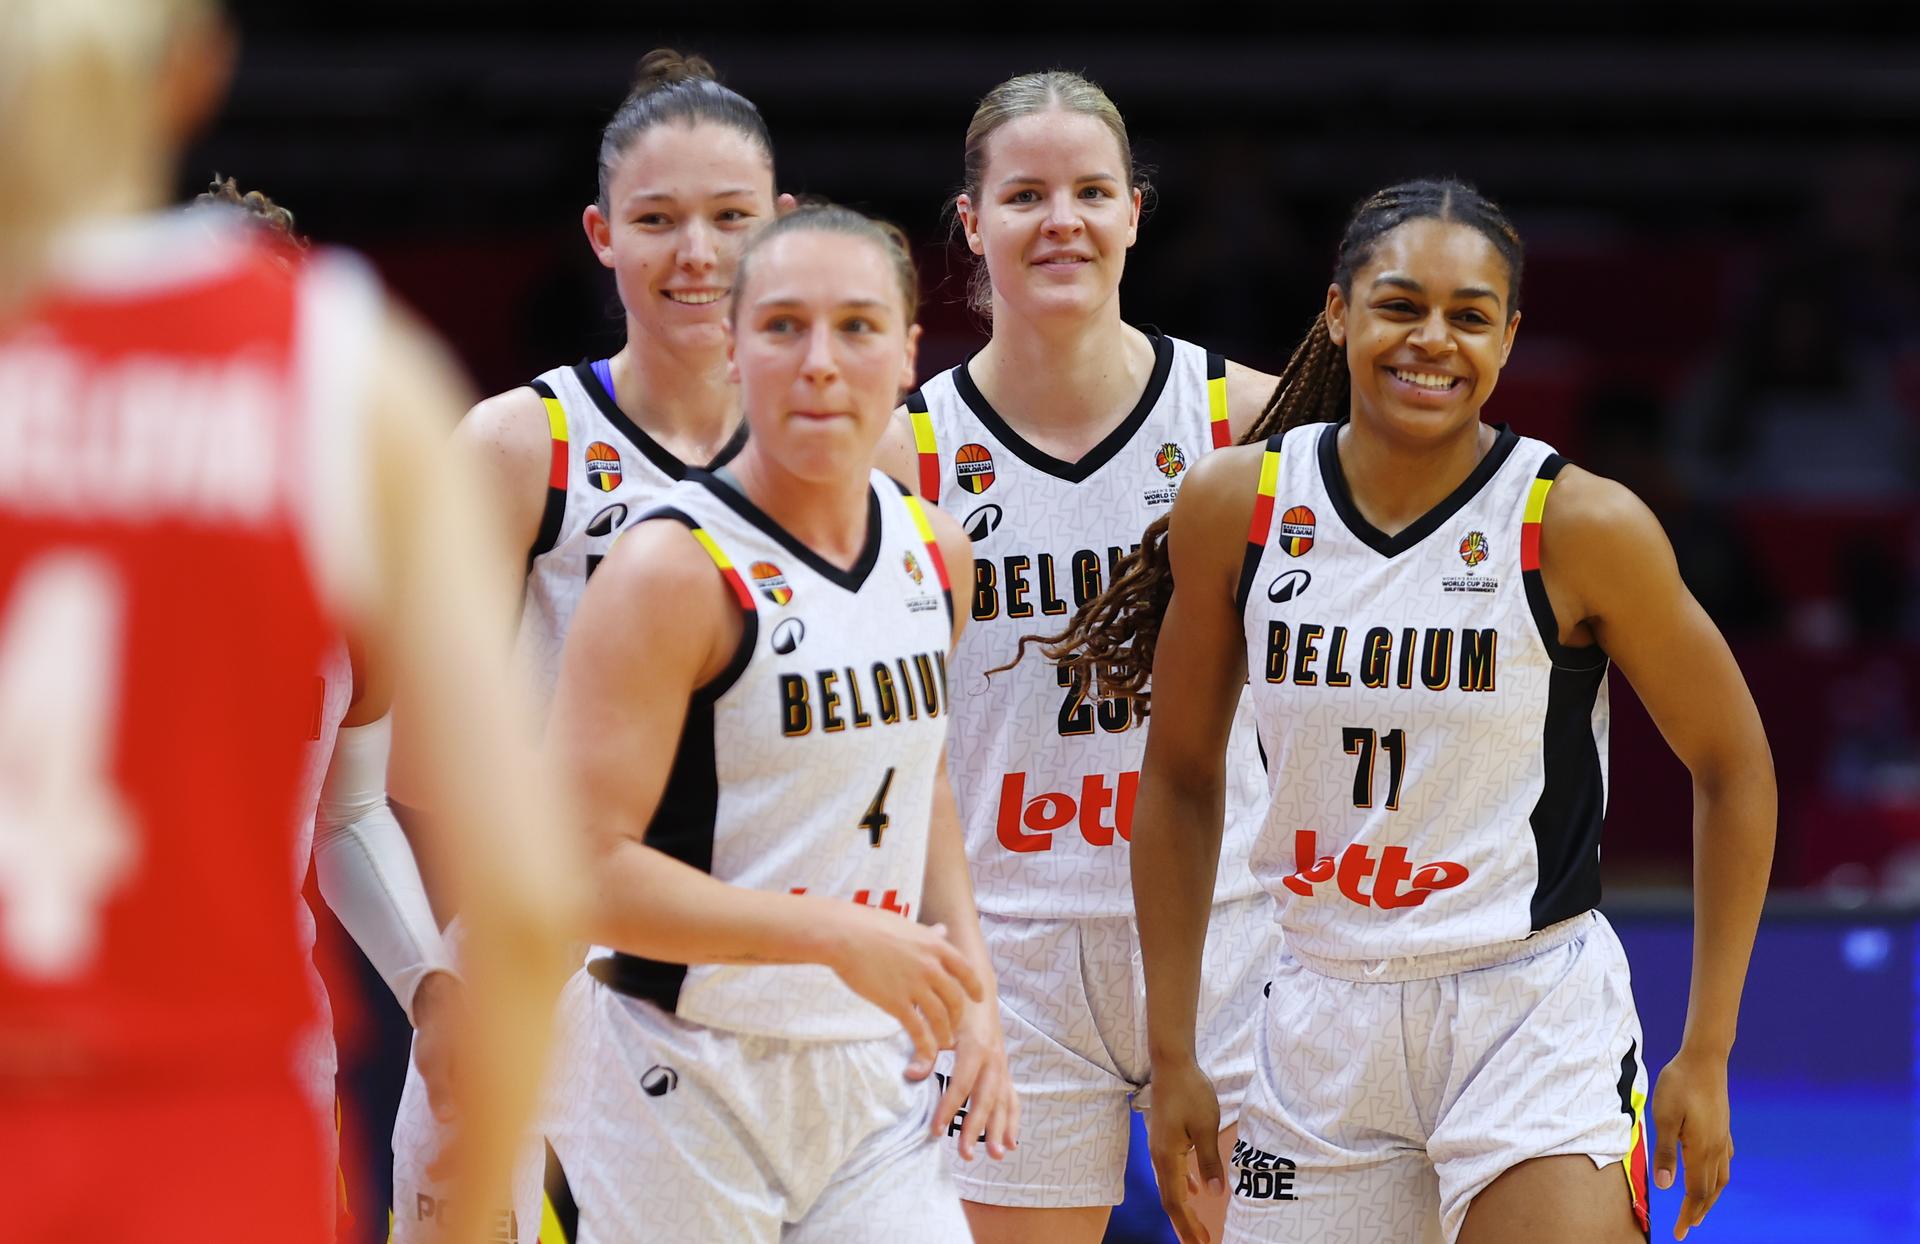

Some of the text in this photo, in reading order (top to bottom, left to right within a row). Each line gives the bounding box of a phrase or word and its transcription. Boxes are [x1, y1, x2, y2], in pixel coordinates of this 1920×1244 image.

[1144, 492, 1168, 500] WORLD
[1265, 620, 1497, 691] BELGIUM
[857, 766, 896, 848] 4
[1342, 727, 1407, 811] 71
[996, 770, 1140, 853] Lott
